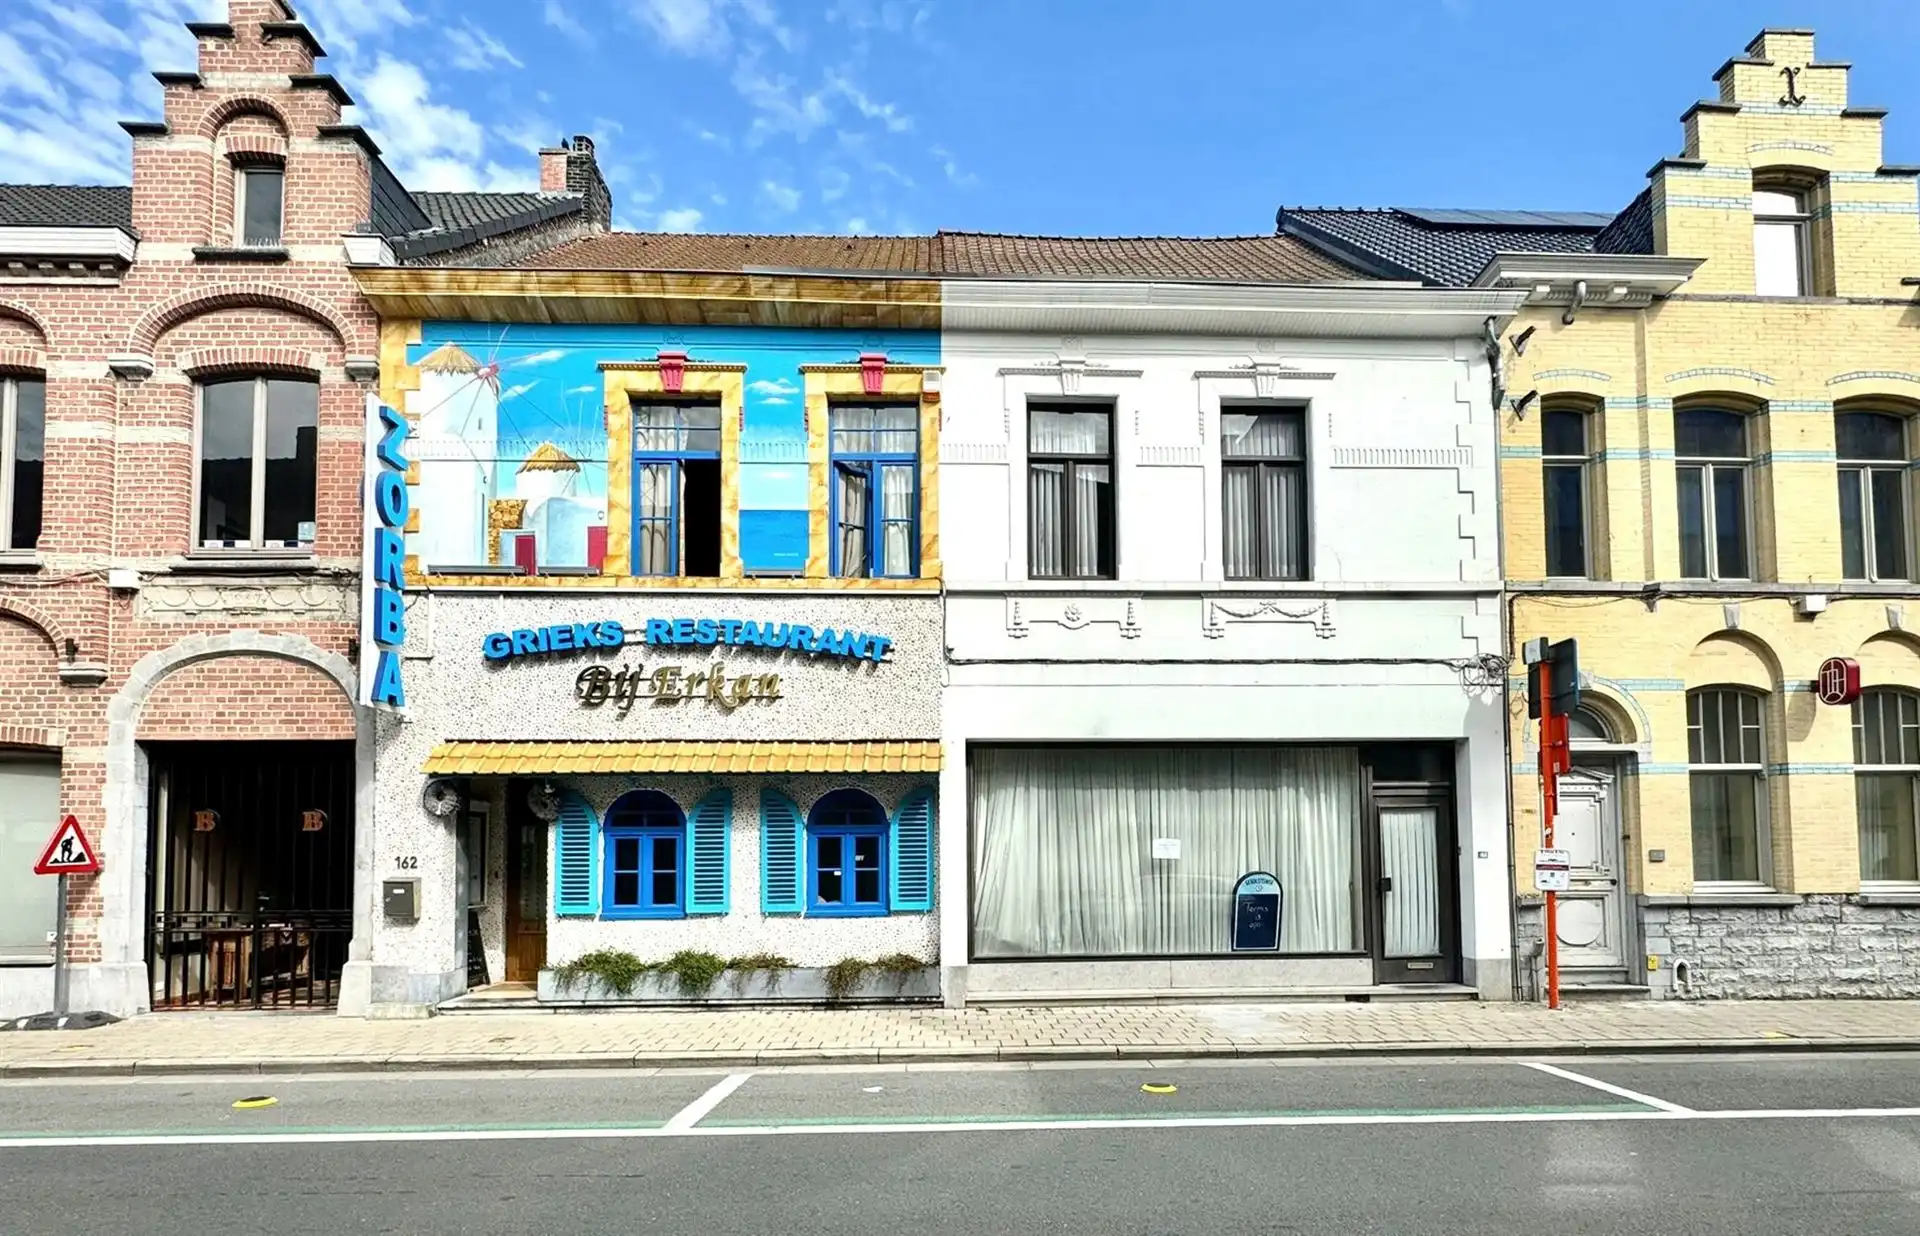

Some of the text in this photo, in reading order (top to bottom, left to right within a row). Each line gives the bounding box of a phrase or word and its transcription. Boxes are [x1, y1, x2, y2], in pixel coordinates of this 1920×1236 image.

[371, 405, 409, 706] ZORBA
[483, 618, 894, 664] GRIEKS RESTAURANT
[575, 661, 781, 712] Bij Erkan
[394, 856, 418, 869] 162
